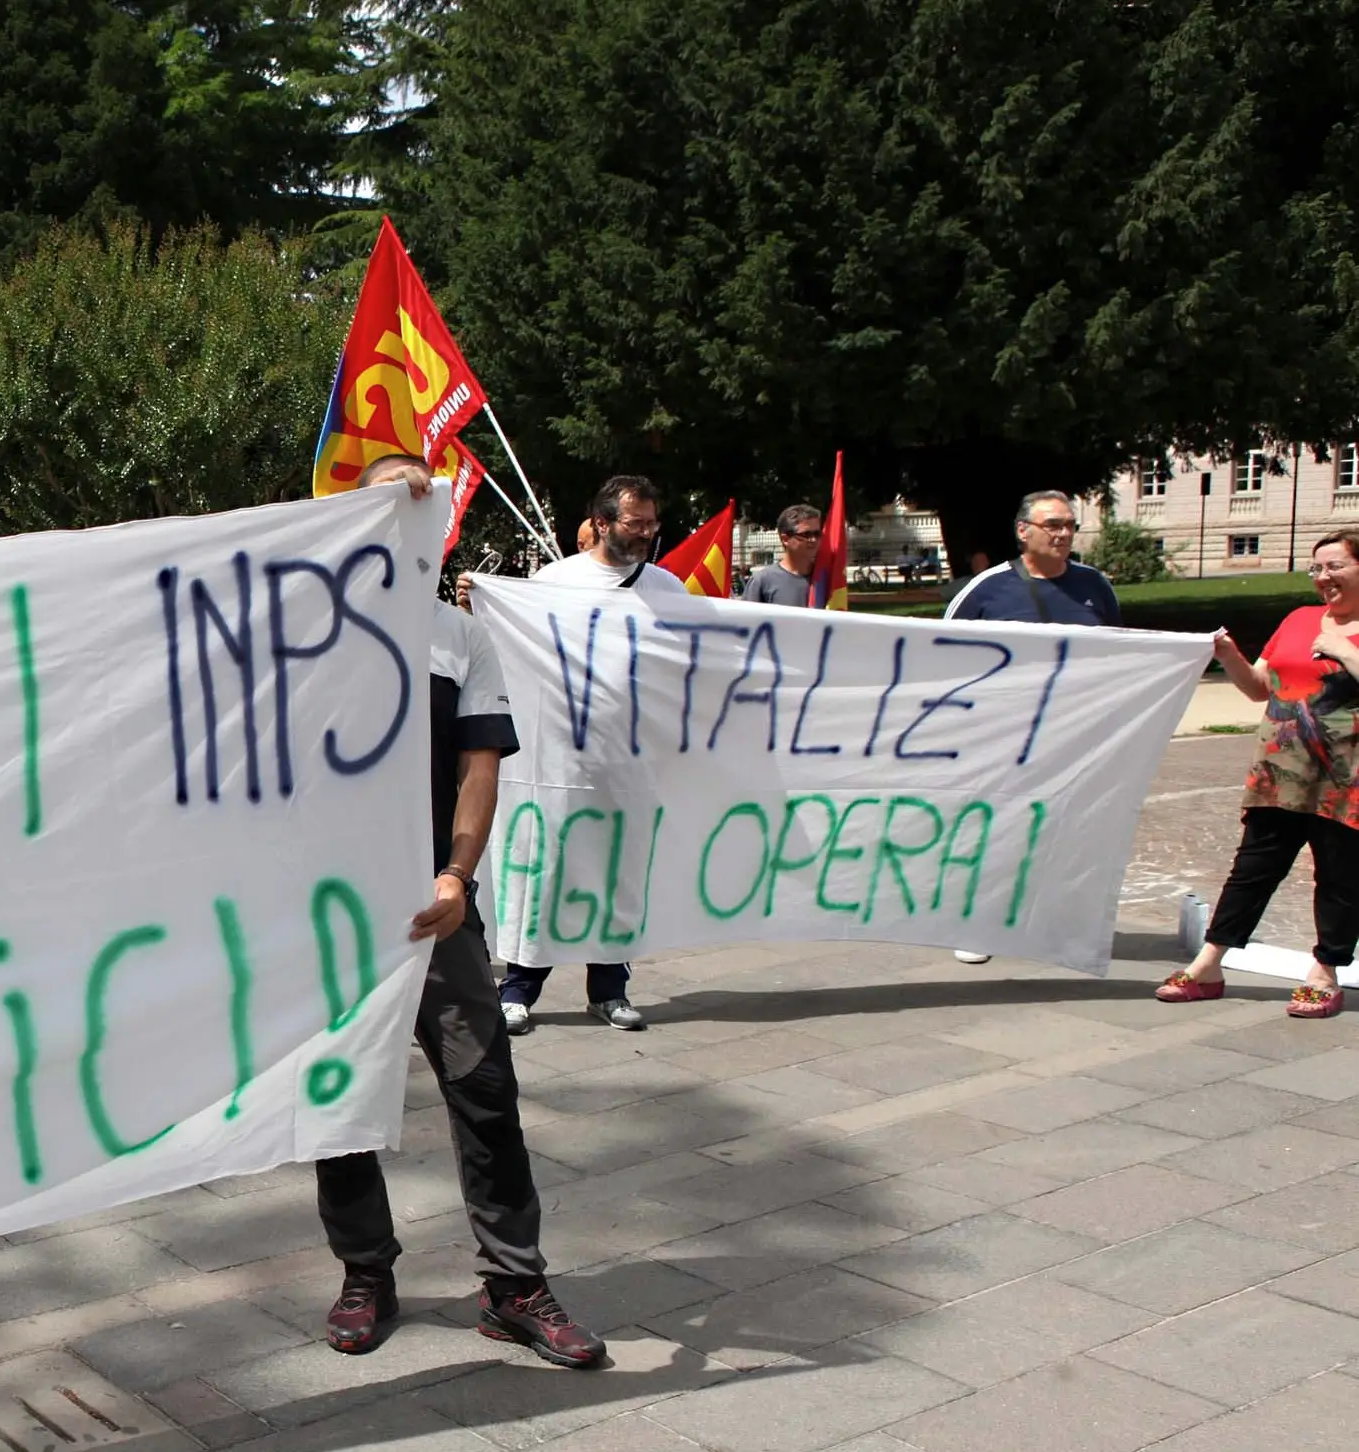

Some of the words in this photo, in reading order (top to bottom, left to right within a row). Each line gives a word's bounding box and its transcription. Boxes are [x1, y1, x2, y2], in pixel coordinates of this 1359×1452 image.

[158, 544, 412, 806] INPS
[546, 606, 1070, 766] VITALIZI
[496, 800, 665, 946] AGLI
[697, 792, 1047, 929] OPERAI
